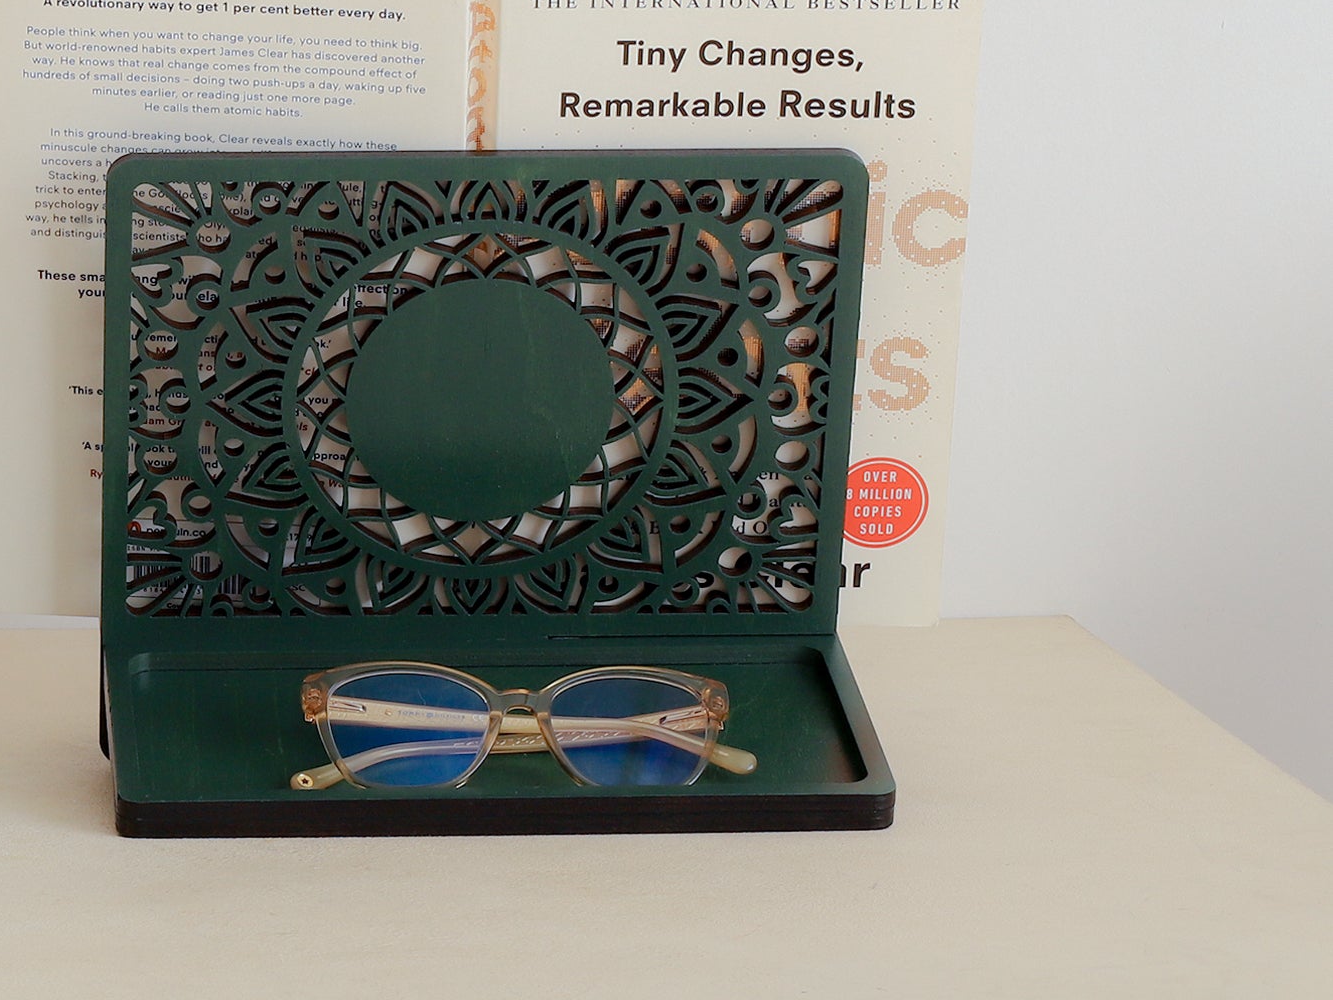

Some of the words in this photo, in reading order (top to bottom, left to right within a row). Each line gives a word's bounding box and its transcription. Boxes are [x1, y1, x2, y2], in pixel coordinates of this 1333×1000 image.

[148, 2, 175, 14] way
[178, 1, 192, 11] to
[196, 2, 218, 15] get
[222, 2, 228, 13] 1
[233, 5, 256, 16] per
[260, 5, 290, 15] cent
[293, 4, 334, 16] better
[338, 9, 374, 21] every
[378, 7, 406, 22] day.
[27, 25, 66, 39] People
[69, 27, 96, 38] think
[99, 28, 130, 39] when
[133, 32, 153, 42] you
[157, 32, 184, 41] want
[187, 32, 199, 41] to
[202, 32, 244, 46] change
[247, 36, 273, 46] your
[275, 34, 296, 46] life,
[299, 38, 320, 48] you
[324, 37, 352, 47] need
[355, 38, 367, 47] to
[370, 38, 398, 49] think
[401, 39, 422, 52] big.
[24, 40, 42, 50] But
[46, 41, 138, 54] world-renowned
[142, 44, 176, 55] habits
[179, 47, 216, 59] expert
[219, 47, 255, 58] James
[257, 48, 288, 59] Clear
[291, 50, 311, 60] has
[314, 51, 378, 63] discovered
[381, 54, 426, 65] another
[617, 40, 687, 73] Tiny
[698, 39, 865, 74] Changes,
[32, 57, 57, 68] way.
[60, 55, 76, 65] He
[79, 56, 115, 67] knows
[118, 58, 140, 68] that
[143, 59, 164, 69] real
[167, 60, 209, 73] change
[212, 64, 251, 72] comes
[254, 63, 280, 73] from
[283, 64, 301, 74] the
[304, 66, 366, 78] compound
[369, 67, 402, 78] effect
[405, 68, 417, 78] of
[22, 69, 76, 80] hundreds
[79, 71, 90, 81] of
[93, 72, 123, 82] small
[126, 73, 180, 84] decisions
[193, 75, 225, 89] doing
[229, 77, 250, 87] two
[253, 78, 306, 92] push-ups
[318, 80, 341, 93] day,
[344, 81, 385, 95] waking
[388, 85, 402, 96] up
[405, 83, 426, 94] five
[92, 86, 137, 97] minutes
[140, 88, 178, 100] earlier,
[181, 91, 194, 99] or
[197, 90, 240, 104] reading
[243, 91, 264, 104] just
[267, 94, 288, 102] one
[291, 95, 321, 104] more
[324, 97, 356, 107] page.
[144, 101, 160, 112] He
[163, 102, 188, 113] calls
[192, 103, 220, 114] them
[224, 105, 262, 115] atomic
[266, 106, 303, 117] habits.
[559, 91, 766, 118] Remarkable
[779, 89, 916, 119] Results
[50, 127, 61, 137] In
[64, 127, 84, 138] this
[87, 129, 181, 145] ground-breaking
[184, 132, 215, 144] book,
[218, 133, 250, 144] Clear
[252, 136, 293, 146] reveals
[296, 138, 336, 151] exactly
[338, 138, 363, 149] how
[365, 139, 397, 150] these
[40, 141, 98, 152] minuscule
[41, 158, 93, 166] uncovers
[95, 159, 102, 167] a
[48, 169, 99, 184] Stacking,
[35, 184, 60, 194] trick
[63, 185, 74, 194] to
[34, 198, 99, 212] psychology
[26, 214, 50, 225] way,
[53, 212, 67, 222] he
[70, 213, 93, 223] tells
[30, 227, 51, 236] and
[37, 269, 76, 281] These
[863, 471, 897, 483] OVER
[846, 488, 853, 500] 8
[859, 488, 912, 500] MILLION
[854, 505, 902, 518] COPIES
[859, 523, 894, 535] SOLD
